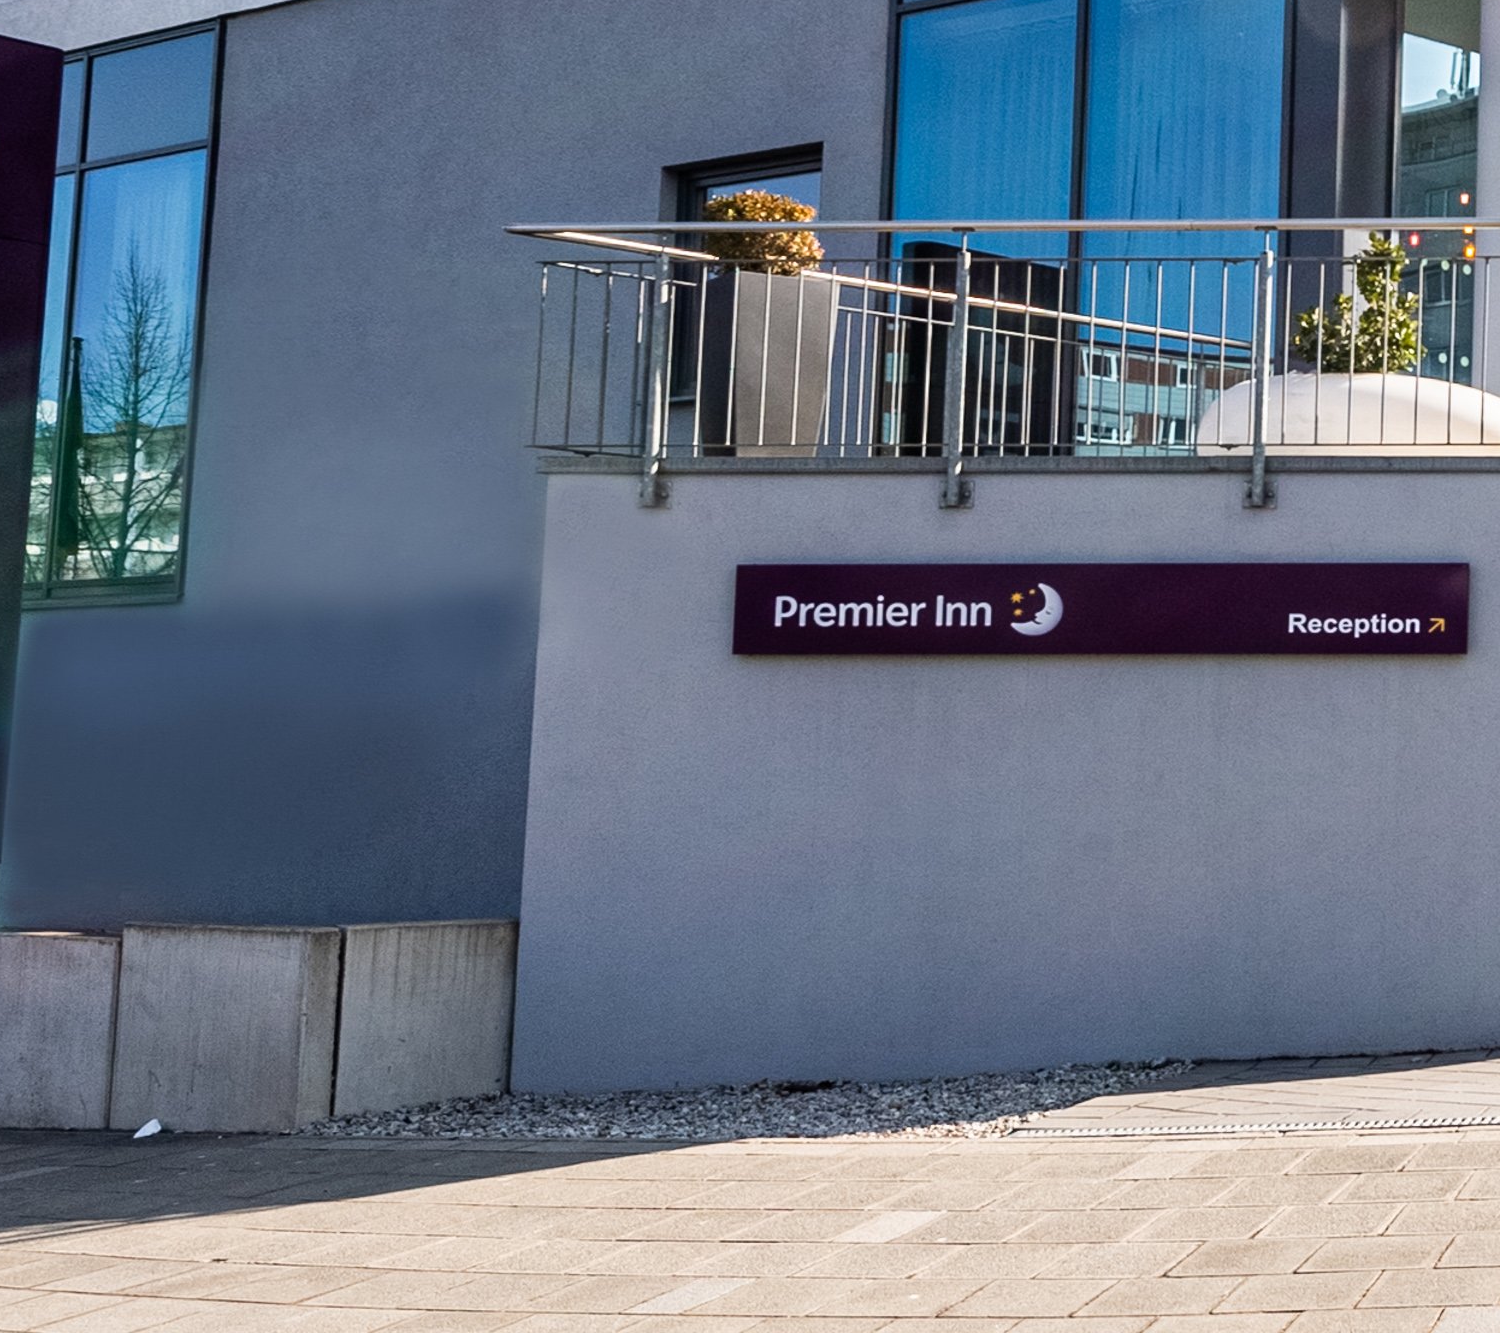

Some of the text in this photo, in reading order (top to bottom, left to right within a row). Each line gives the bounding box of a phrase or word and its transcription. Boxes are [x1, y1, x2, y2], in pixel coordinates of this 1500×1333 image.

[774, 594, 993, 627] Premier Inn
[1288, 613, 1421, 639] Reception
